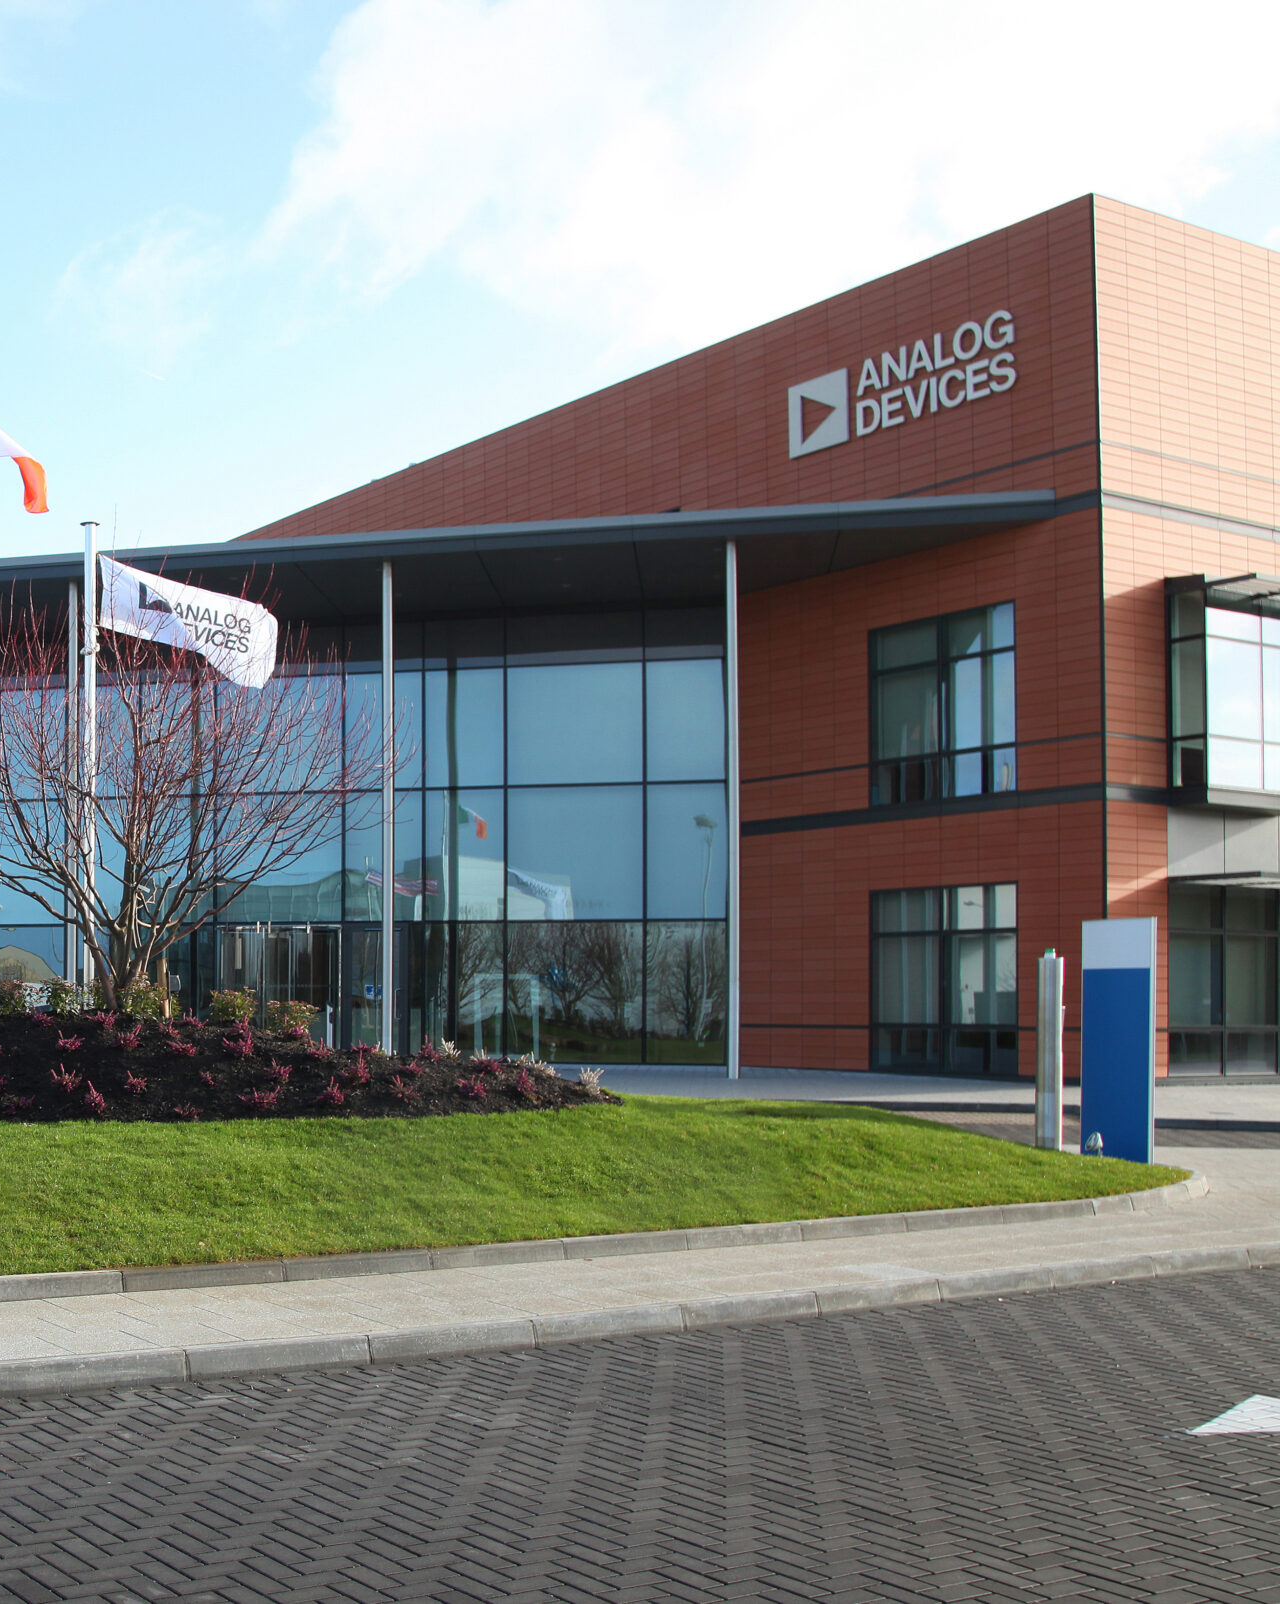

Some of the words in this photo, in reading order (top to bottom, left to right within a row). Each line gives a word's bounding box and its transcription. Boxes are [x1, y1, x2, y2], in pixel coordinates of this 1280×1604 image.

[856, 309, 1015, 396] ANALOG
[856, 351, 1017, 436] DEVICES
[174, 602, 251, 634] ANALOG
[183, 622, 250, 653] VICES
